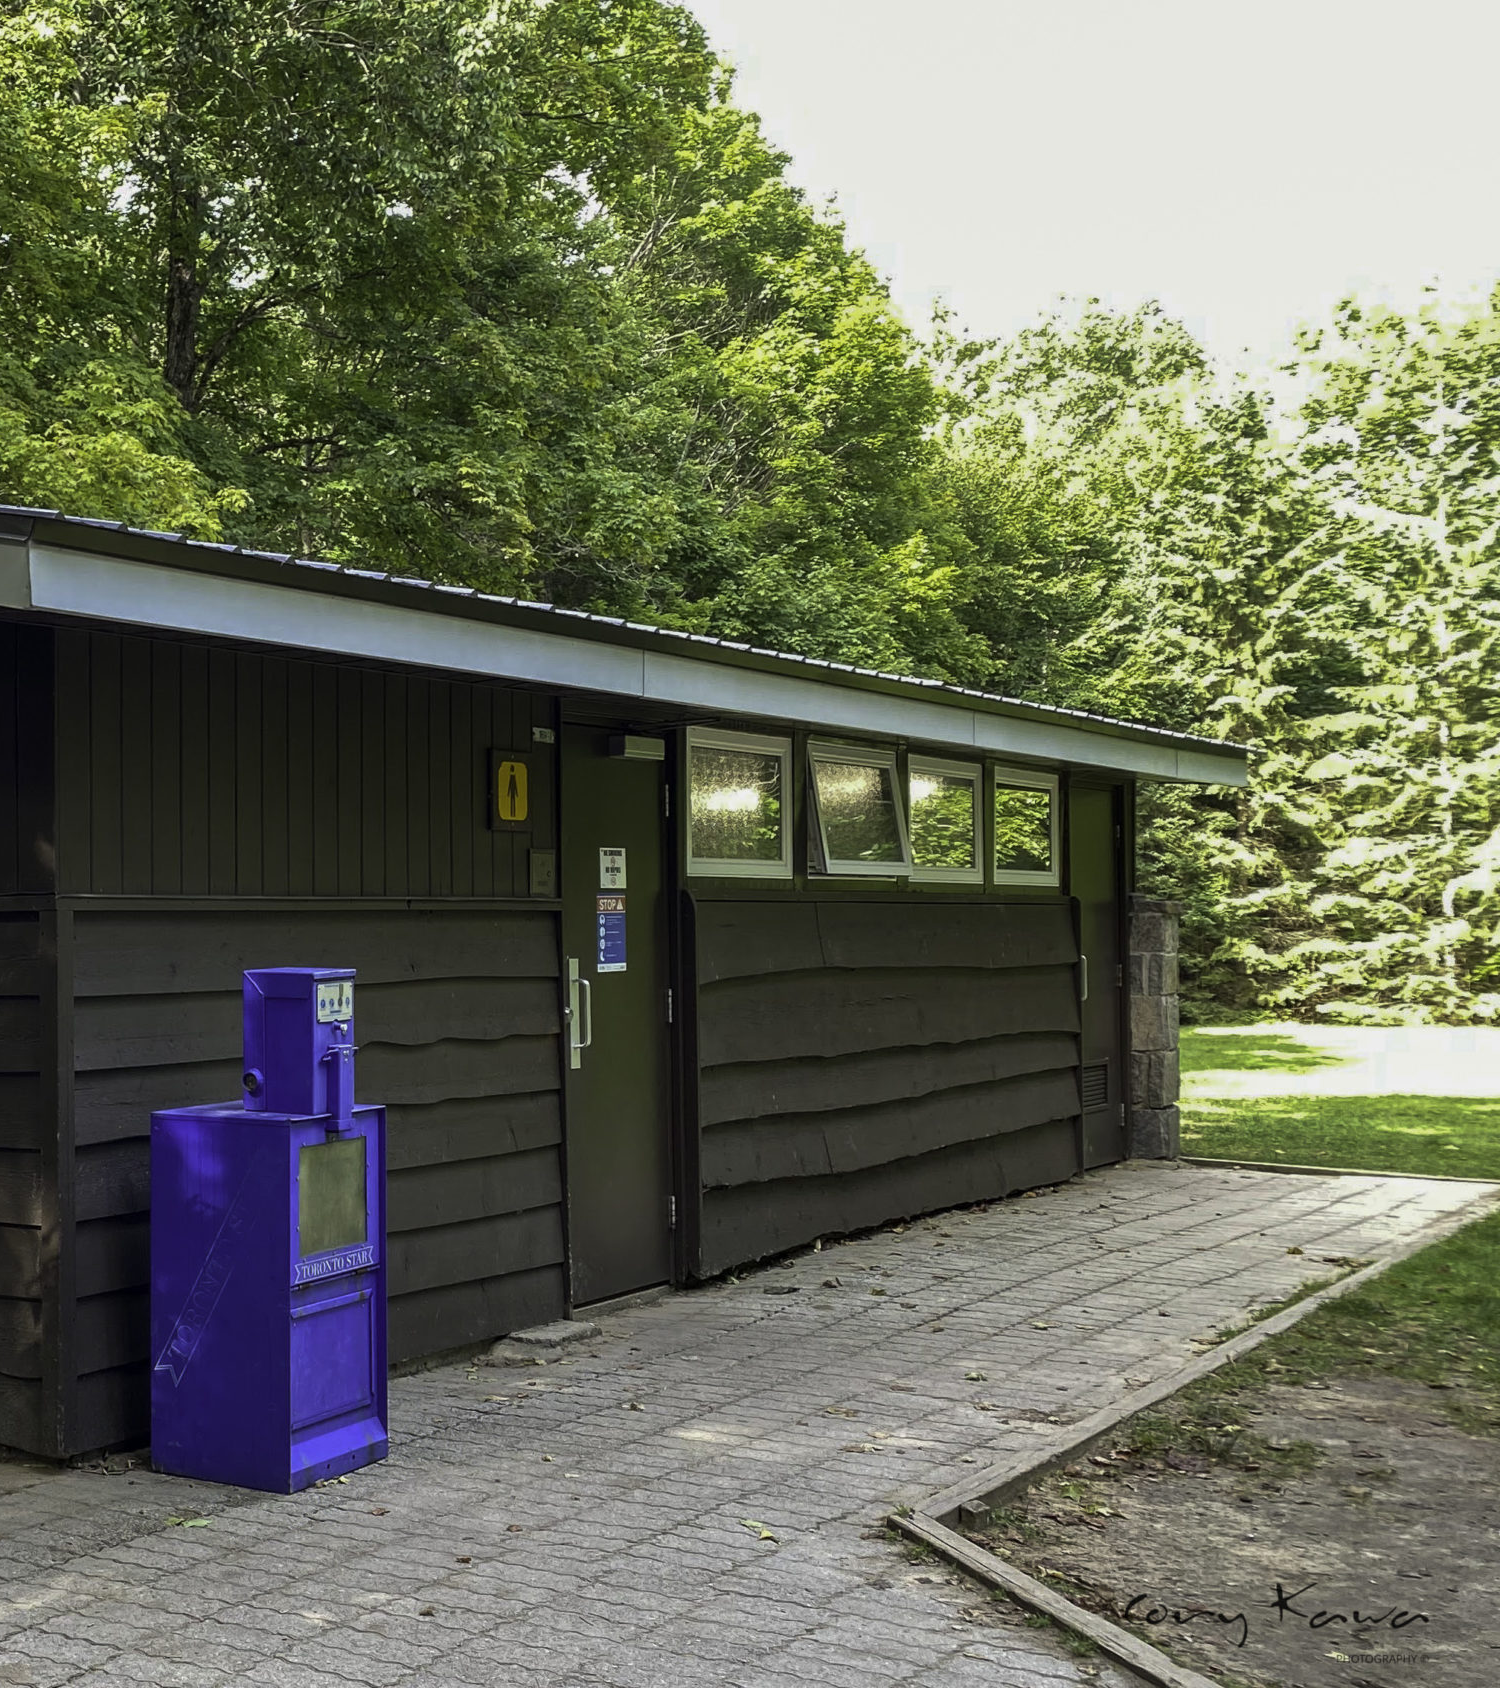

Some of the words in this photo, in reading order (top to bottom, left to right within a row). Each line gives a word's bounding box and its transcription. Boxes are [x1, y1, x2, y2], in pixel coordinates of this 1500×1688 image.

[599, 899, 616, 910] STOP
[301, 1257, 344, 1279] TORONTO
[346, 1250, 368, 1267] STAR
